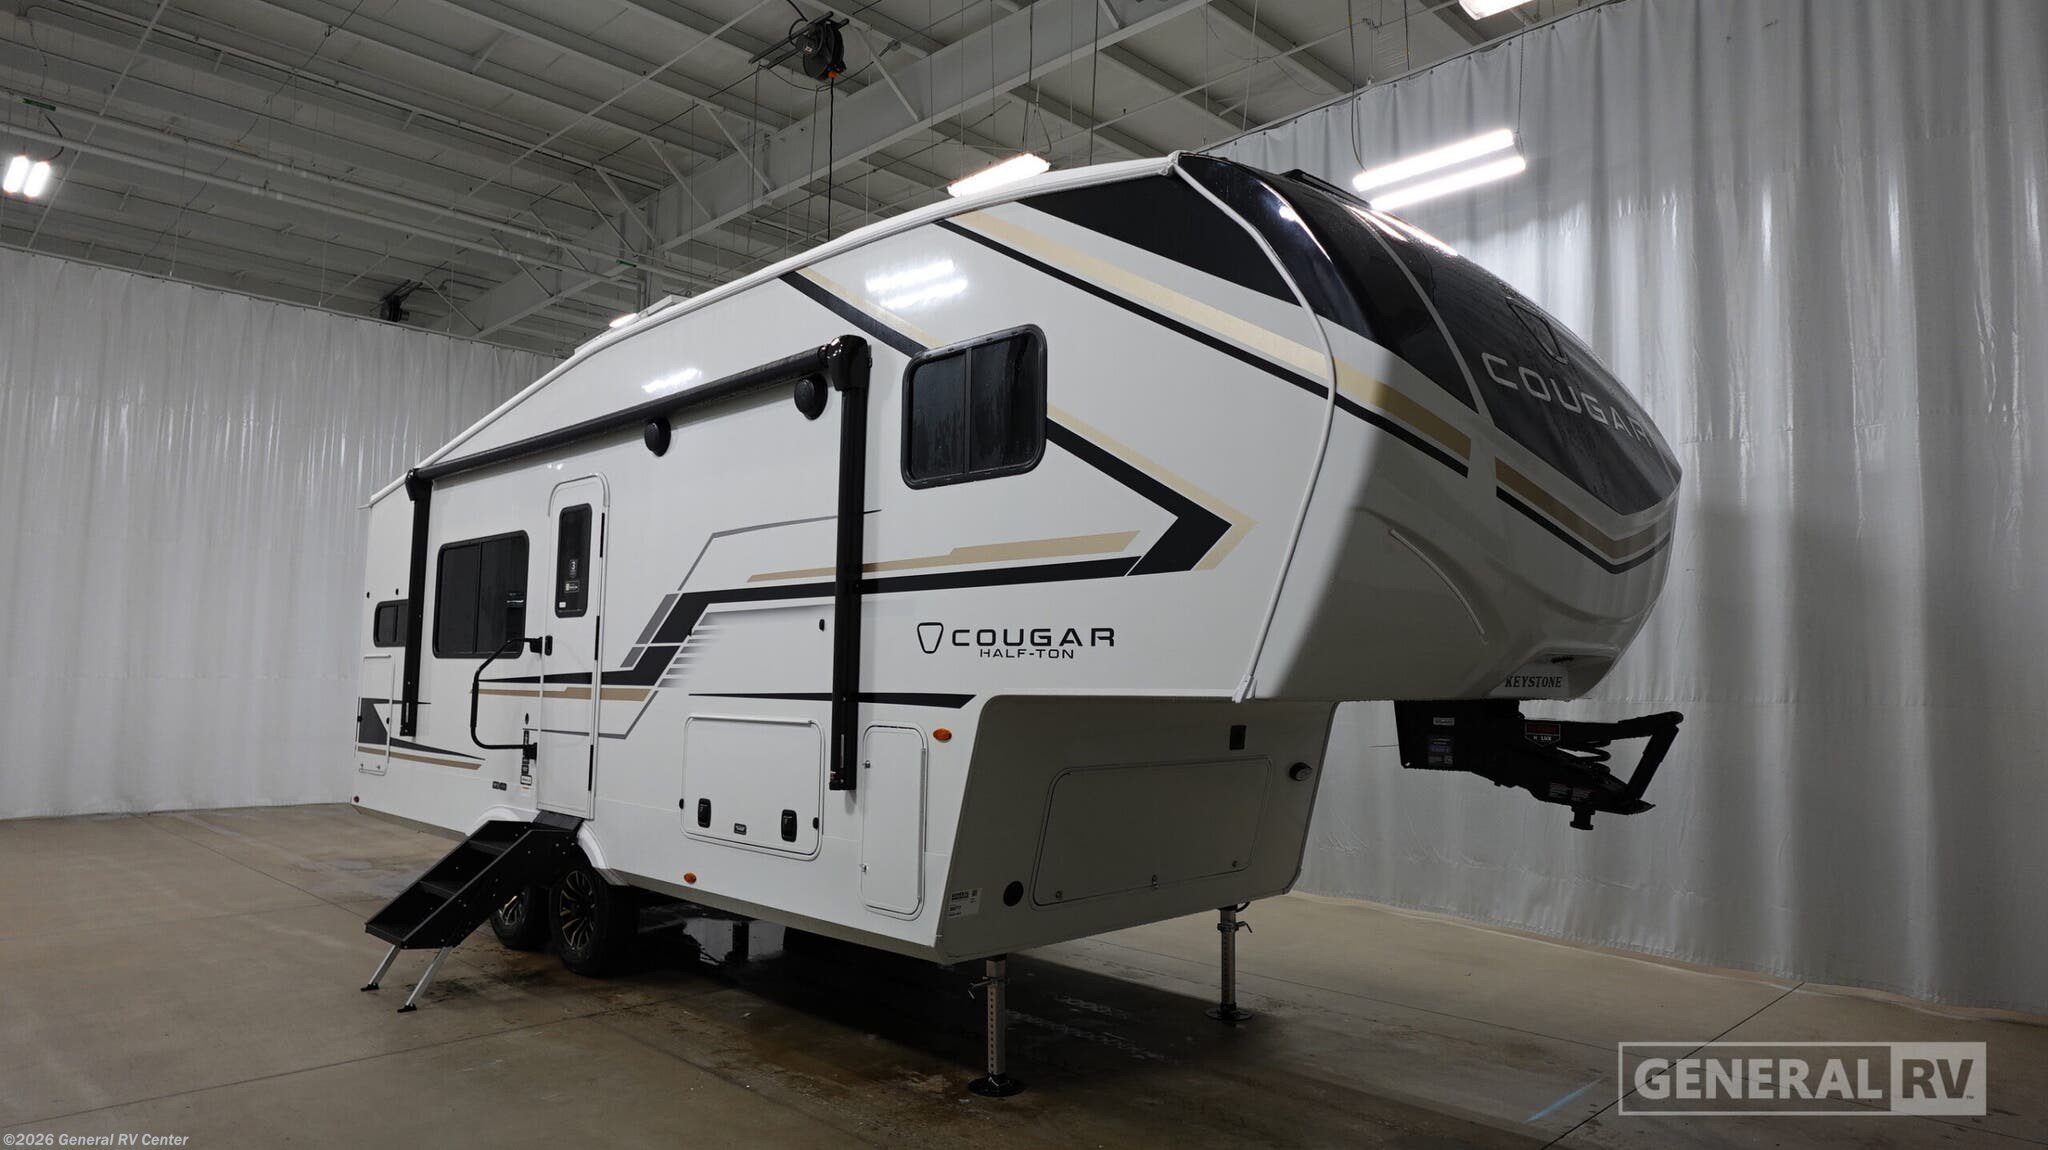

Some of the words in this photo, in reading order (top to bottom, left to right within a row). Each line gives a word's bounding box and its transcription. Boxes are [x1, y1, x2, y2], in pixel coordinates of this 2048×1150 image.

[1481, 352, 1654, 448] COUGAR
[952, 628, 1115, 647] COUGAR
[980, 648, 1074, 659] HALF-TON
[1505, 675, 1562, 688] KEYSTONE
